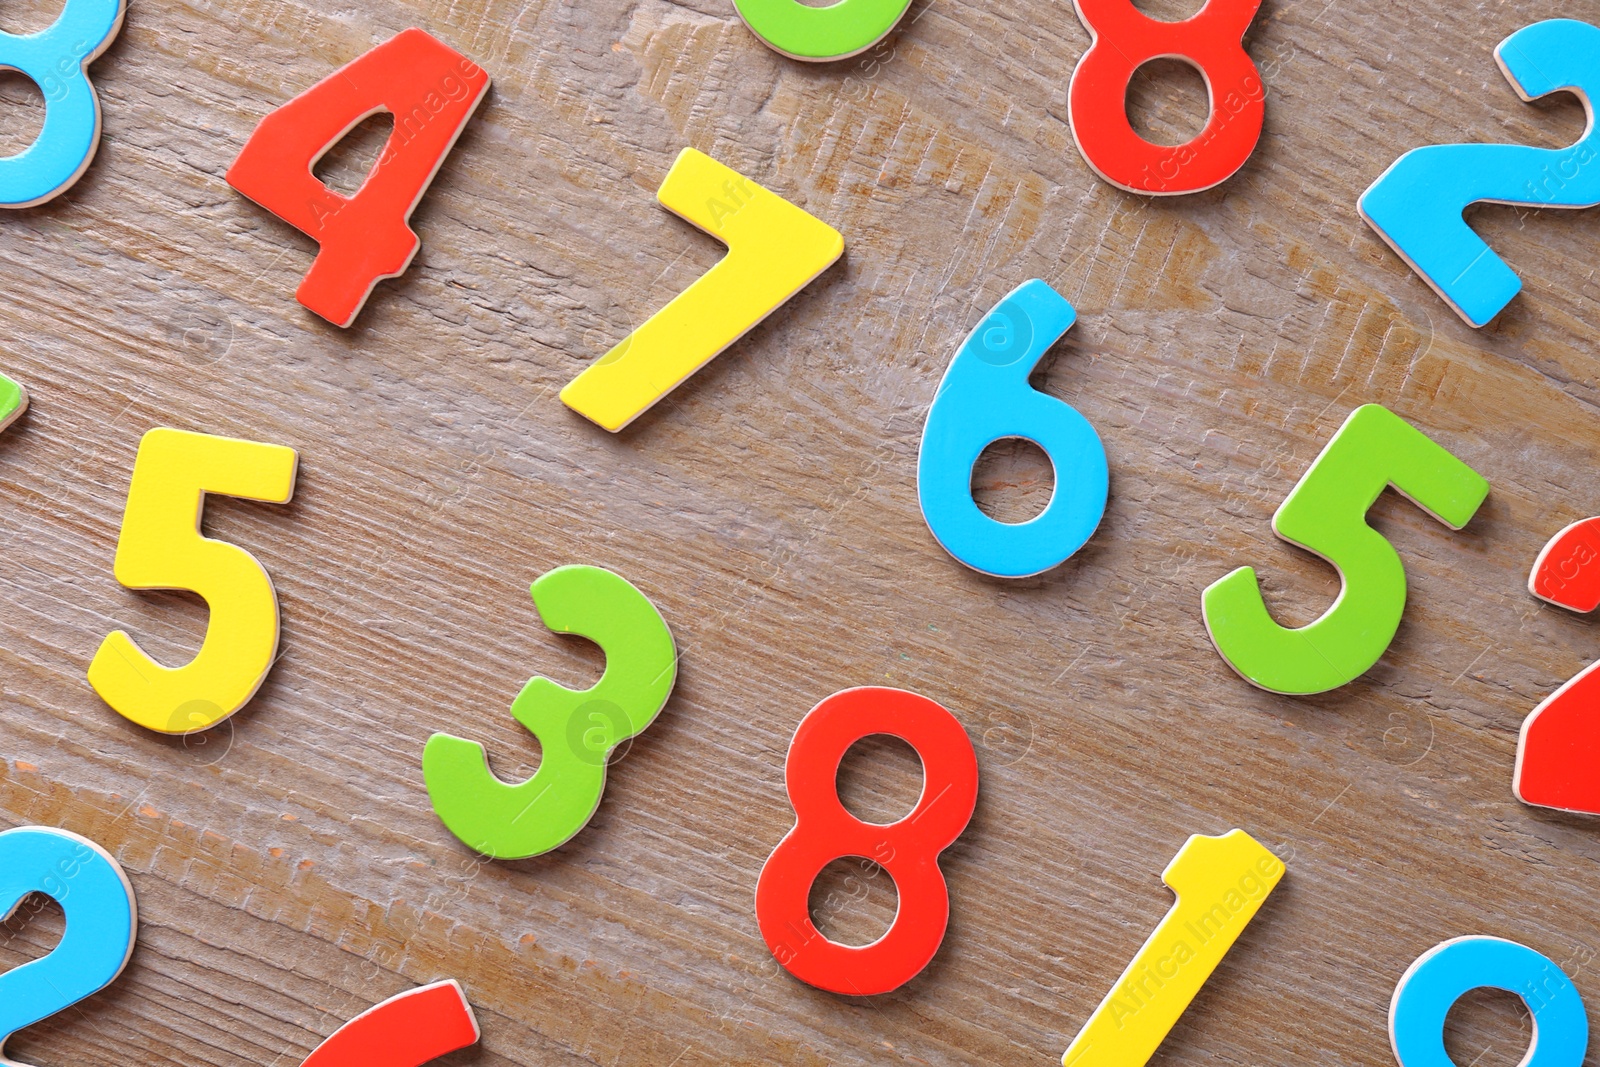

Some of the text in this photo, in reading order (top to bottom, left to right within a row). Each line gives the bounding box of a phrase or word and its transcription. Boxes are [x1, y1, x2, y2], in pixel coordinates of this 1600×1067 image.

[225, 27, 492, 329] 4
[1068, 0, 1267, 196] 8
[1356, 18, 1600, 330] 2
[558, 146, 847, 434] 7
[916, 277, 1110, 580] 6
[86, 427, 299, 735] 5
[1200, 403, 1491, 697] 5
[422, 564, 678, 861] 3
[755, 685, 980, 997] 8
[1061, 827, 1287, 1067] 1
